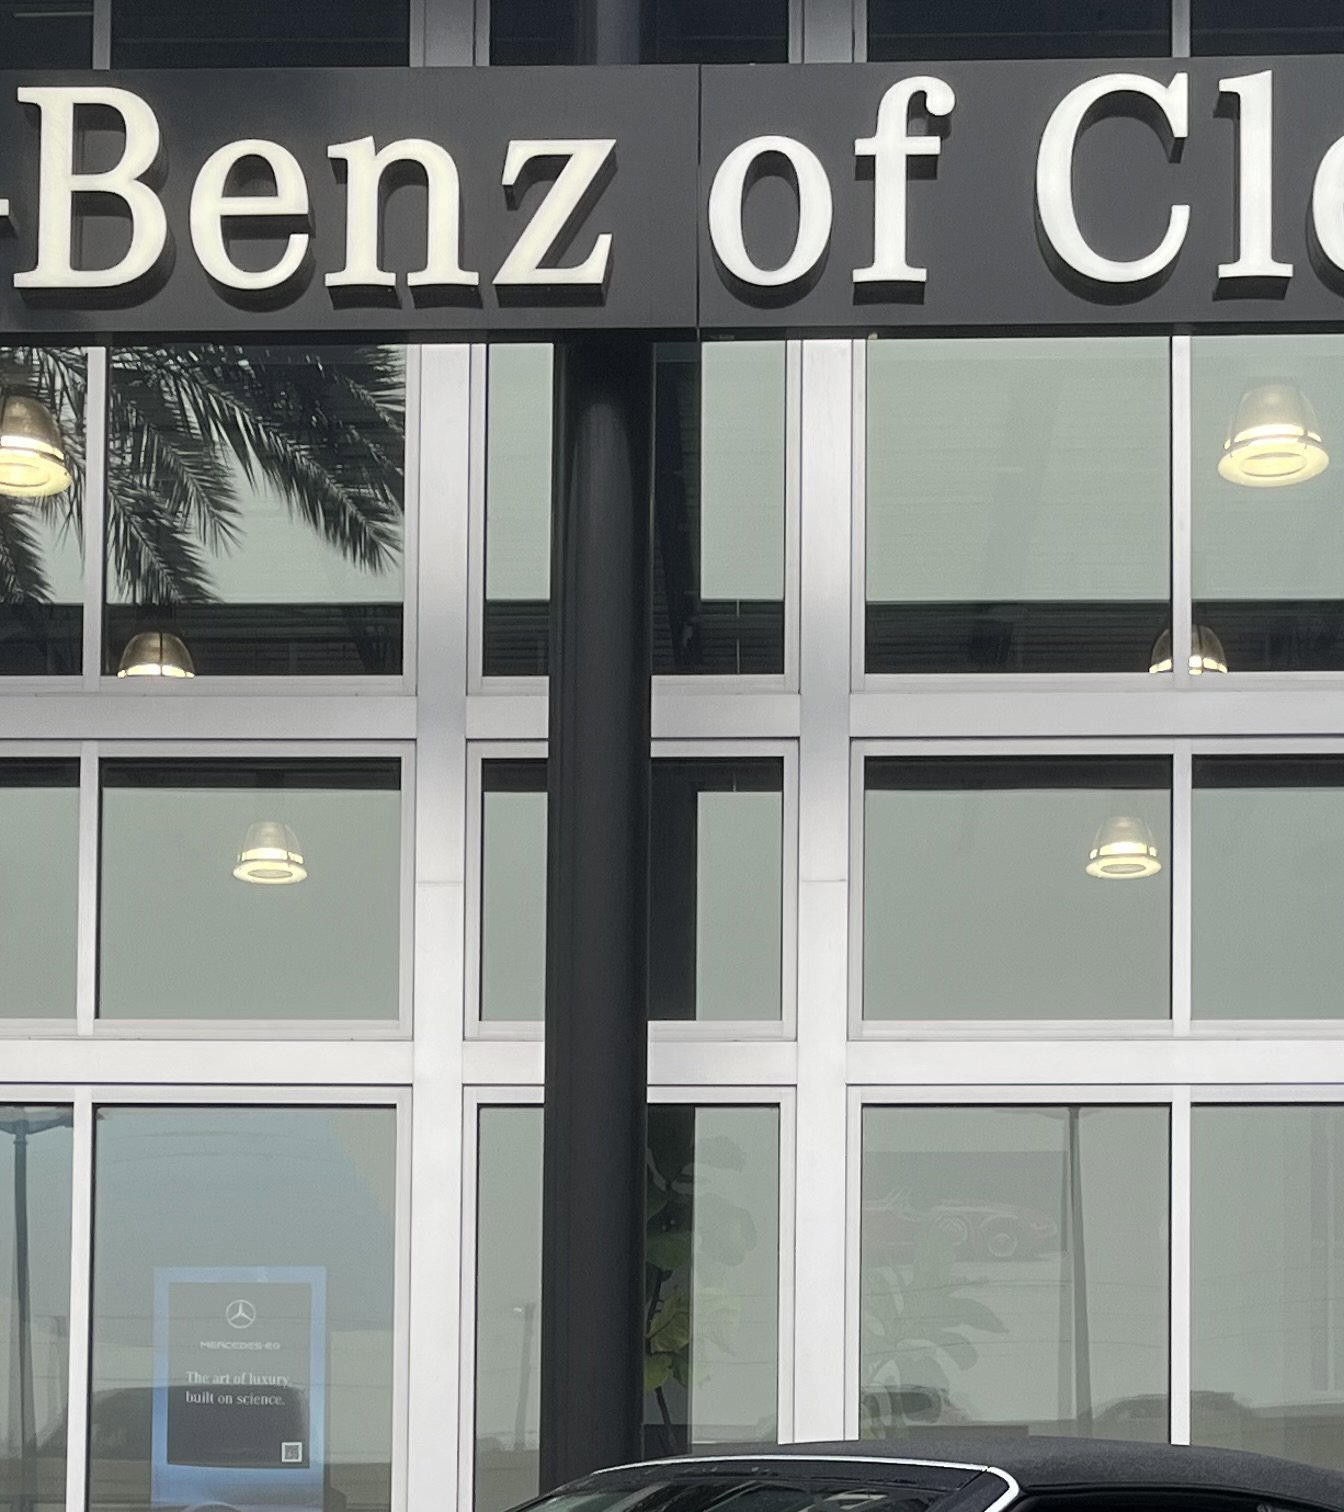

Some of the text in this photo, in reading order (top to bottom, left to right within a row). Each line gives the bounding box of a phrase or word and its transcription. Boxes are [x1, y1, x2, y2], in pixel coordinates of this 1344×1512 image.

[709, 75, 955, 286] of
[186, 1371, 210, 1385] The
[212, 1374, 230, 1385] art
[233, 1372, 248, 1385] of
[185, 1390, 285, 1406] built on science.
